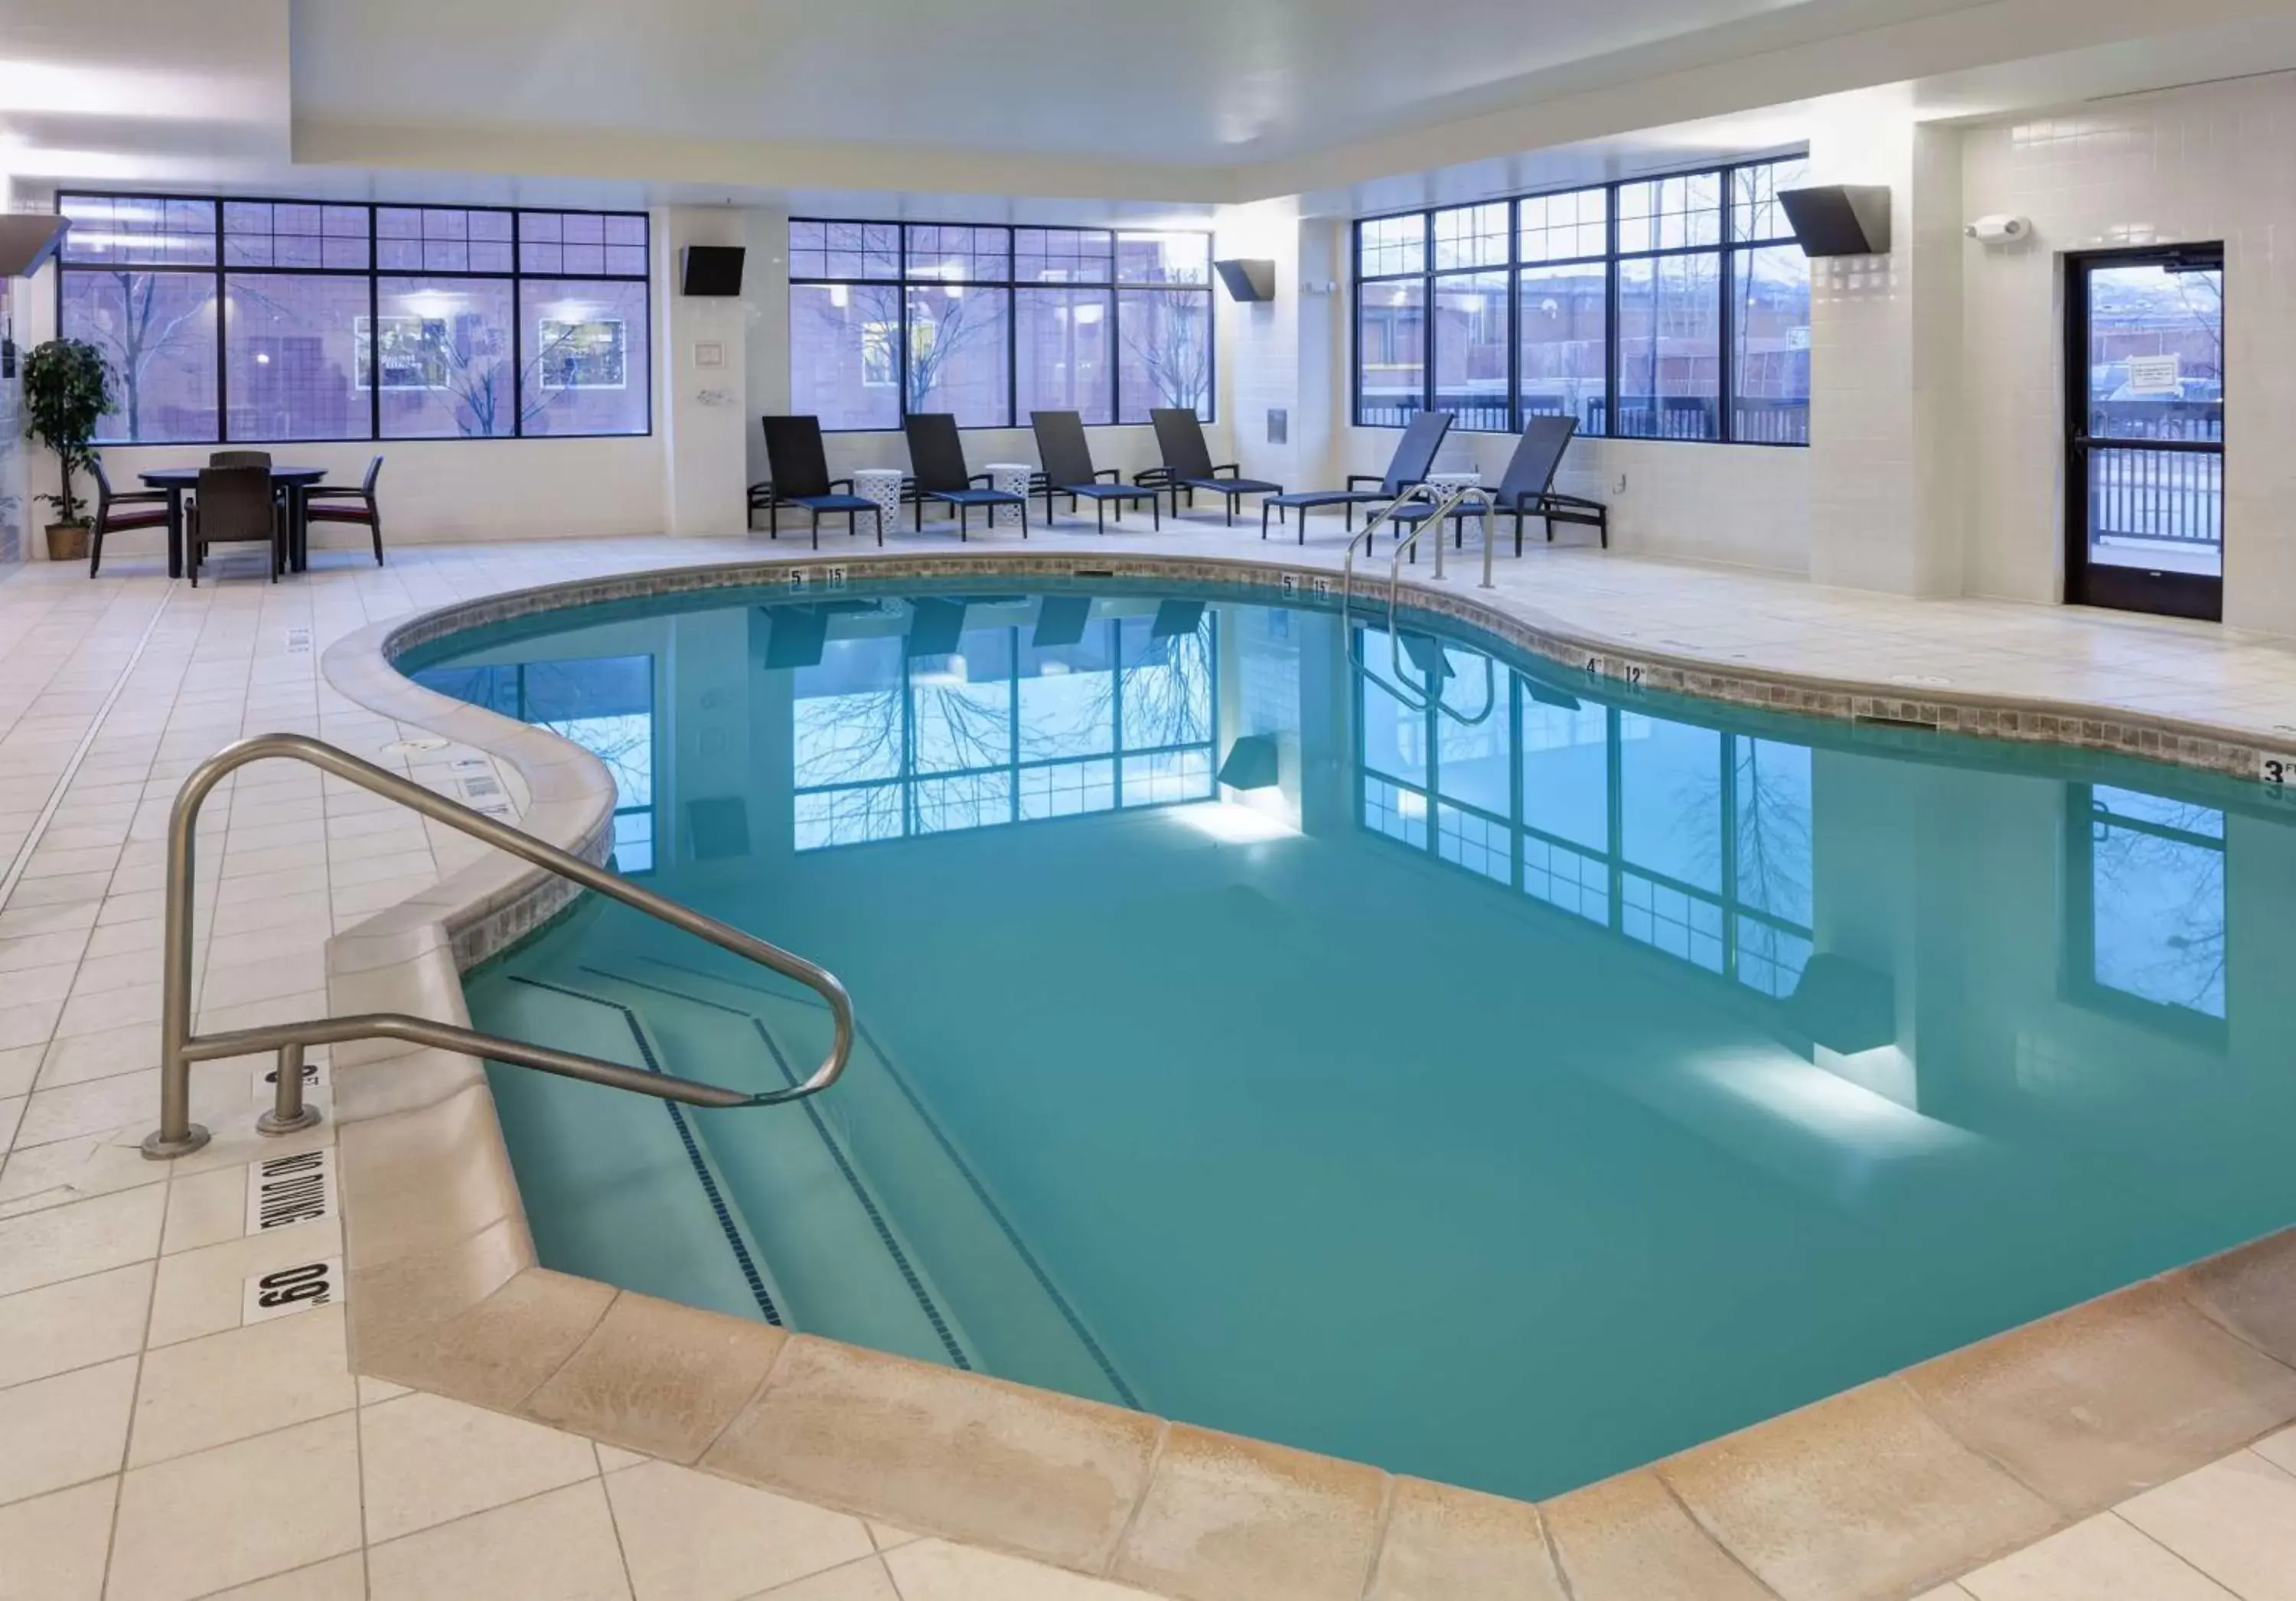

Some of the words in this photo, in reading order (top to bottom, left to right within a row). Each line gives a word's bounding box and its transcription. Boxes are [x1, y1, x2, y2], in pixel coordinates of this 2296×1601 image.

[1587, 657, 1596, 673] 4
[1626, 665, 1641, 683] 12
[2265, 760, 2285, 782] 3
[262, 1151, 323, 1178] NO
[260, 1173, 325, 1230] DIVING
